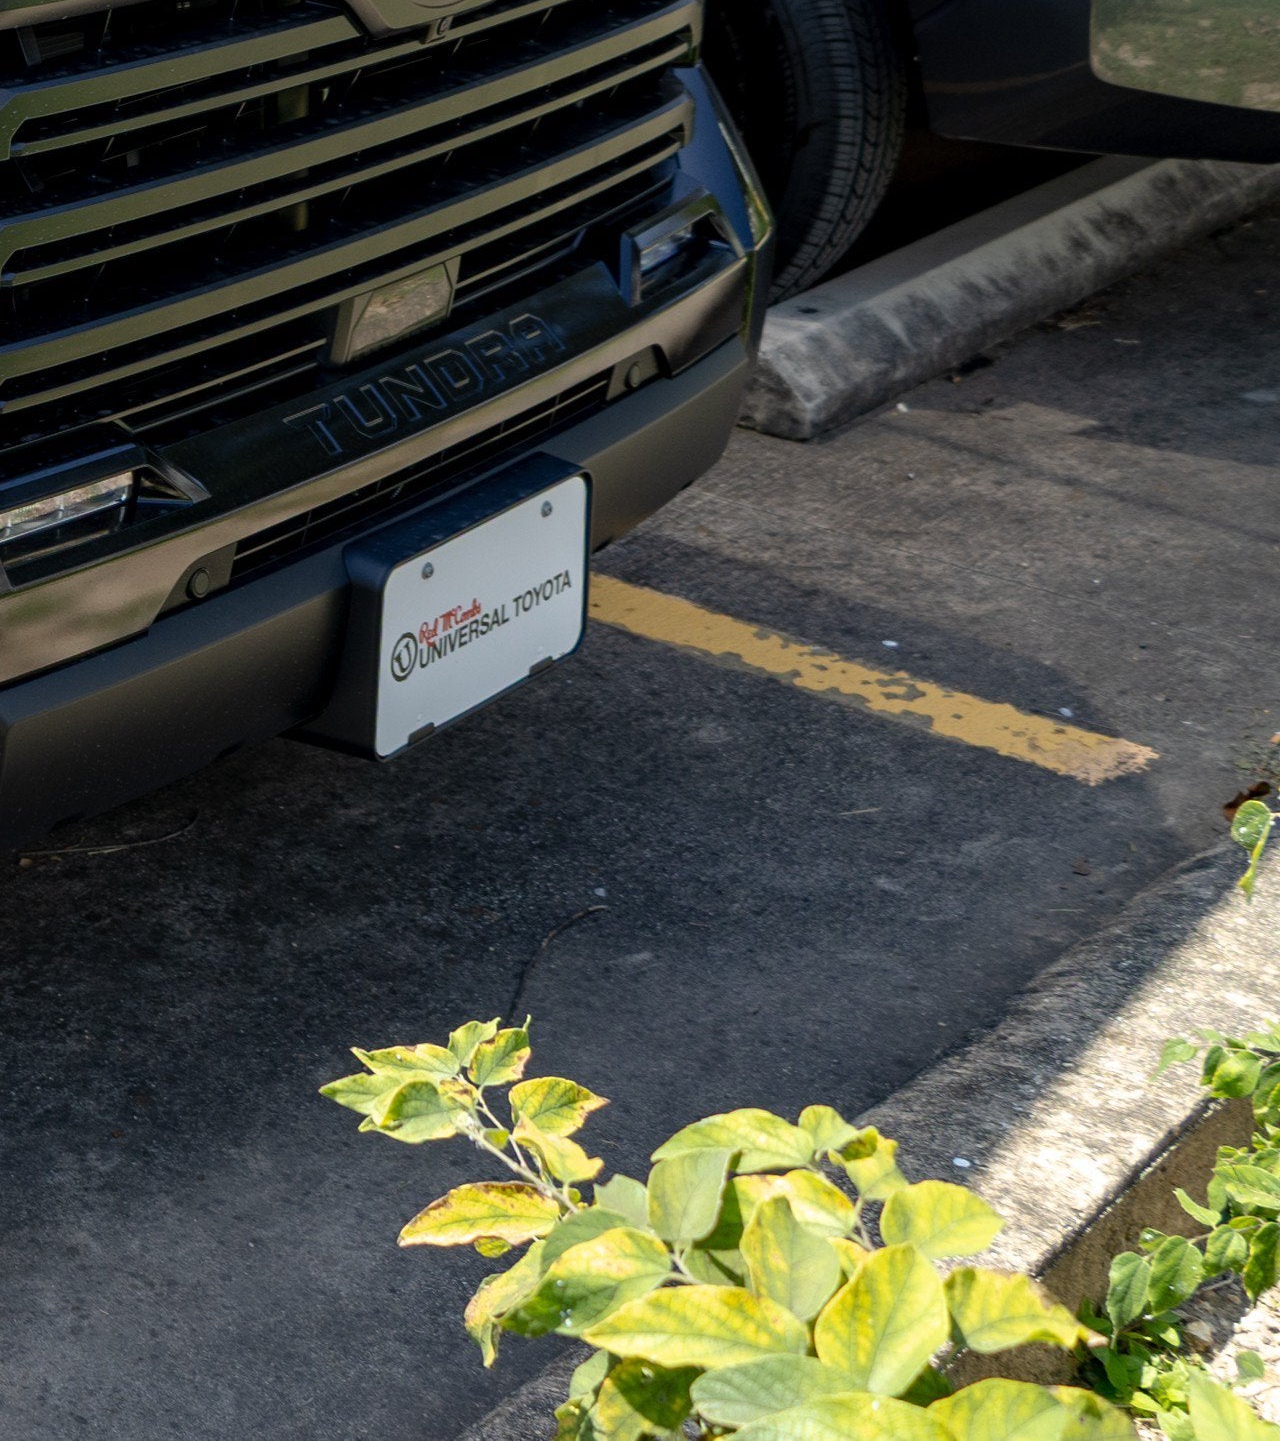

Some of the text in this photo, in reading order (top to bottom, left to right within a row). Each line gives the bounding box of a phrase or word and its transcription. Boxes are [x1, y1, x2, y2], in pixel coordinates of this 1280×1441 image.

[283, 313, 566, 456] TUNDRA
[419, 570, 572, 669] UNIVERSAL TOYOTA
[419, 618, 439, 647] Red
